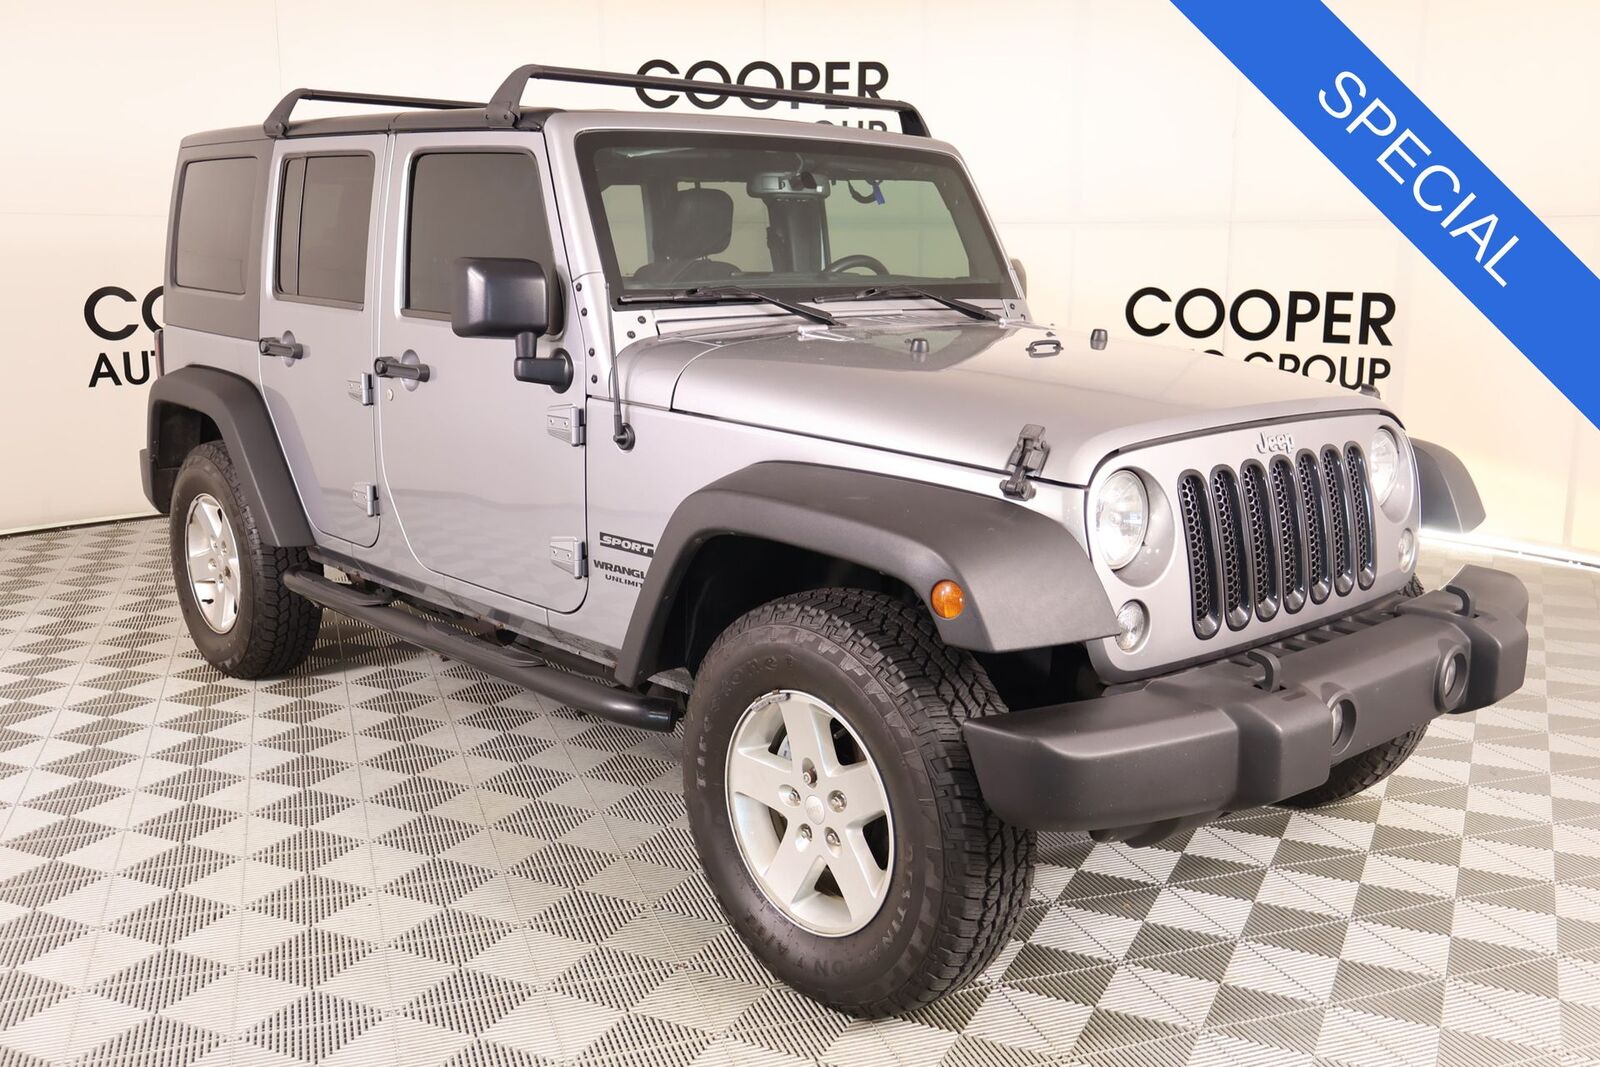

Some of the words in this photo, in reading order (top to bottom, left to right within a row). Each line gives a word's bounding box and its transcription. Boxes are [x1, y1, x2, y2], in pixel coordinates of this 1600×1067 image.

[635, 59, 889, 110] COOPER
[1125, 286, 1396, 346] COOPER
[88, 350, 155, 388] AU
[1256, 431, 1294, 454] Jeep
[600, 534, 654, 555] SPORT
